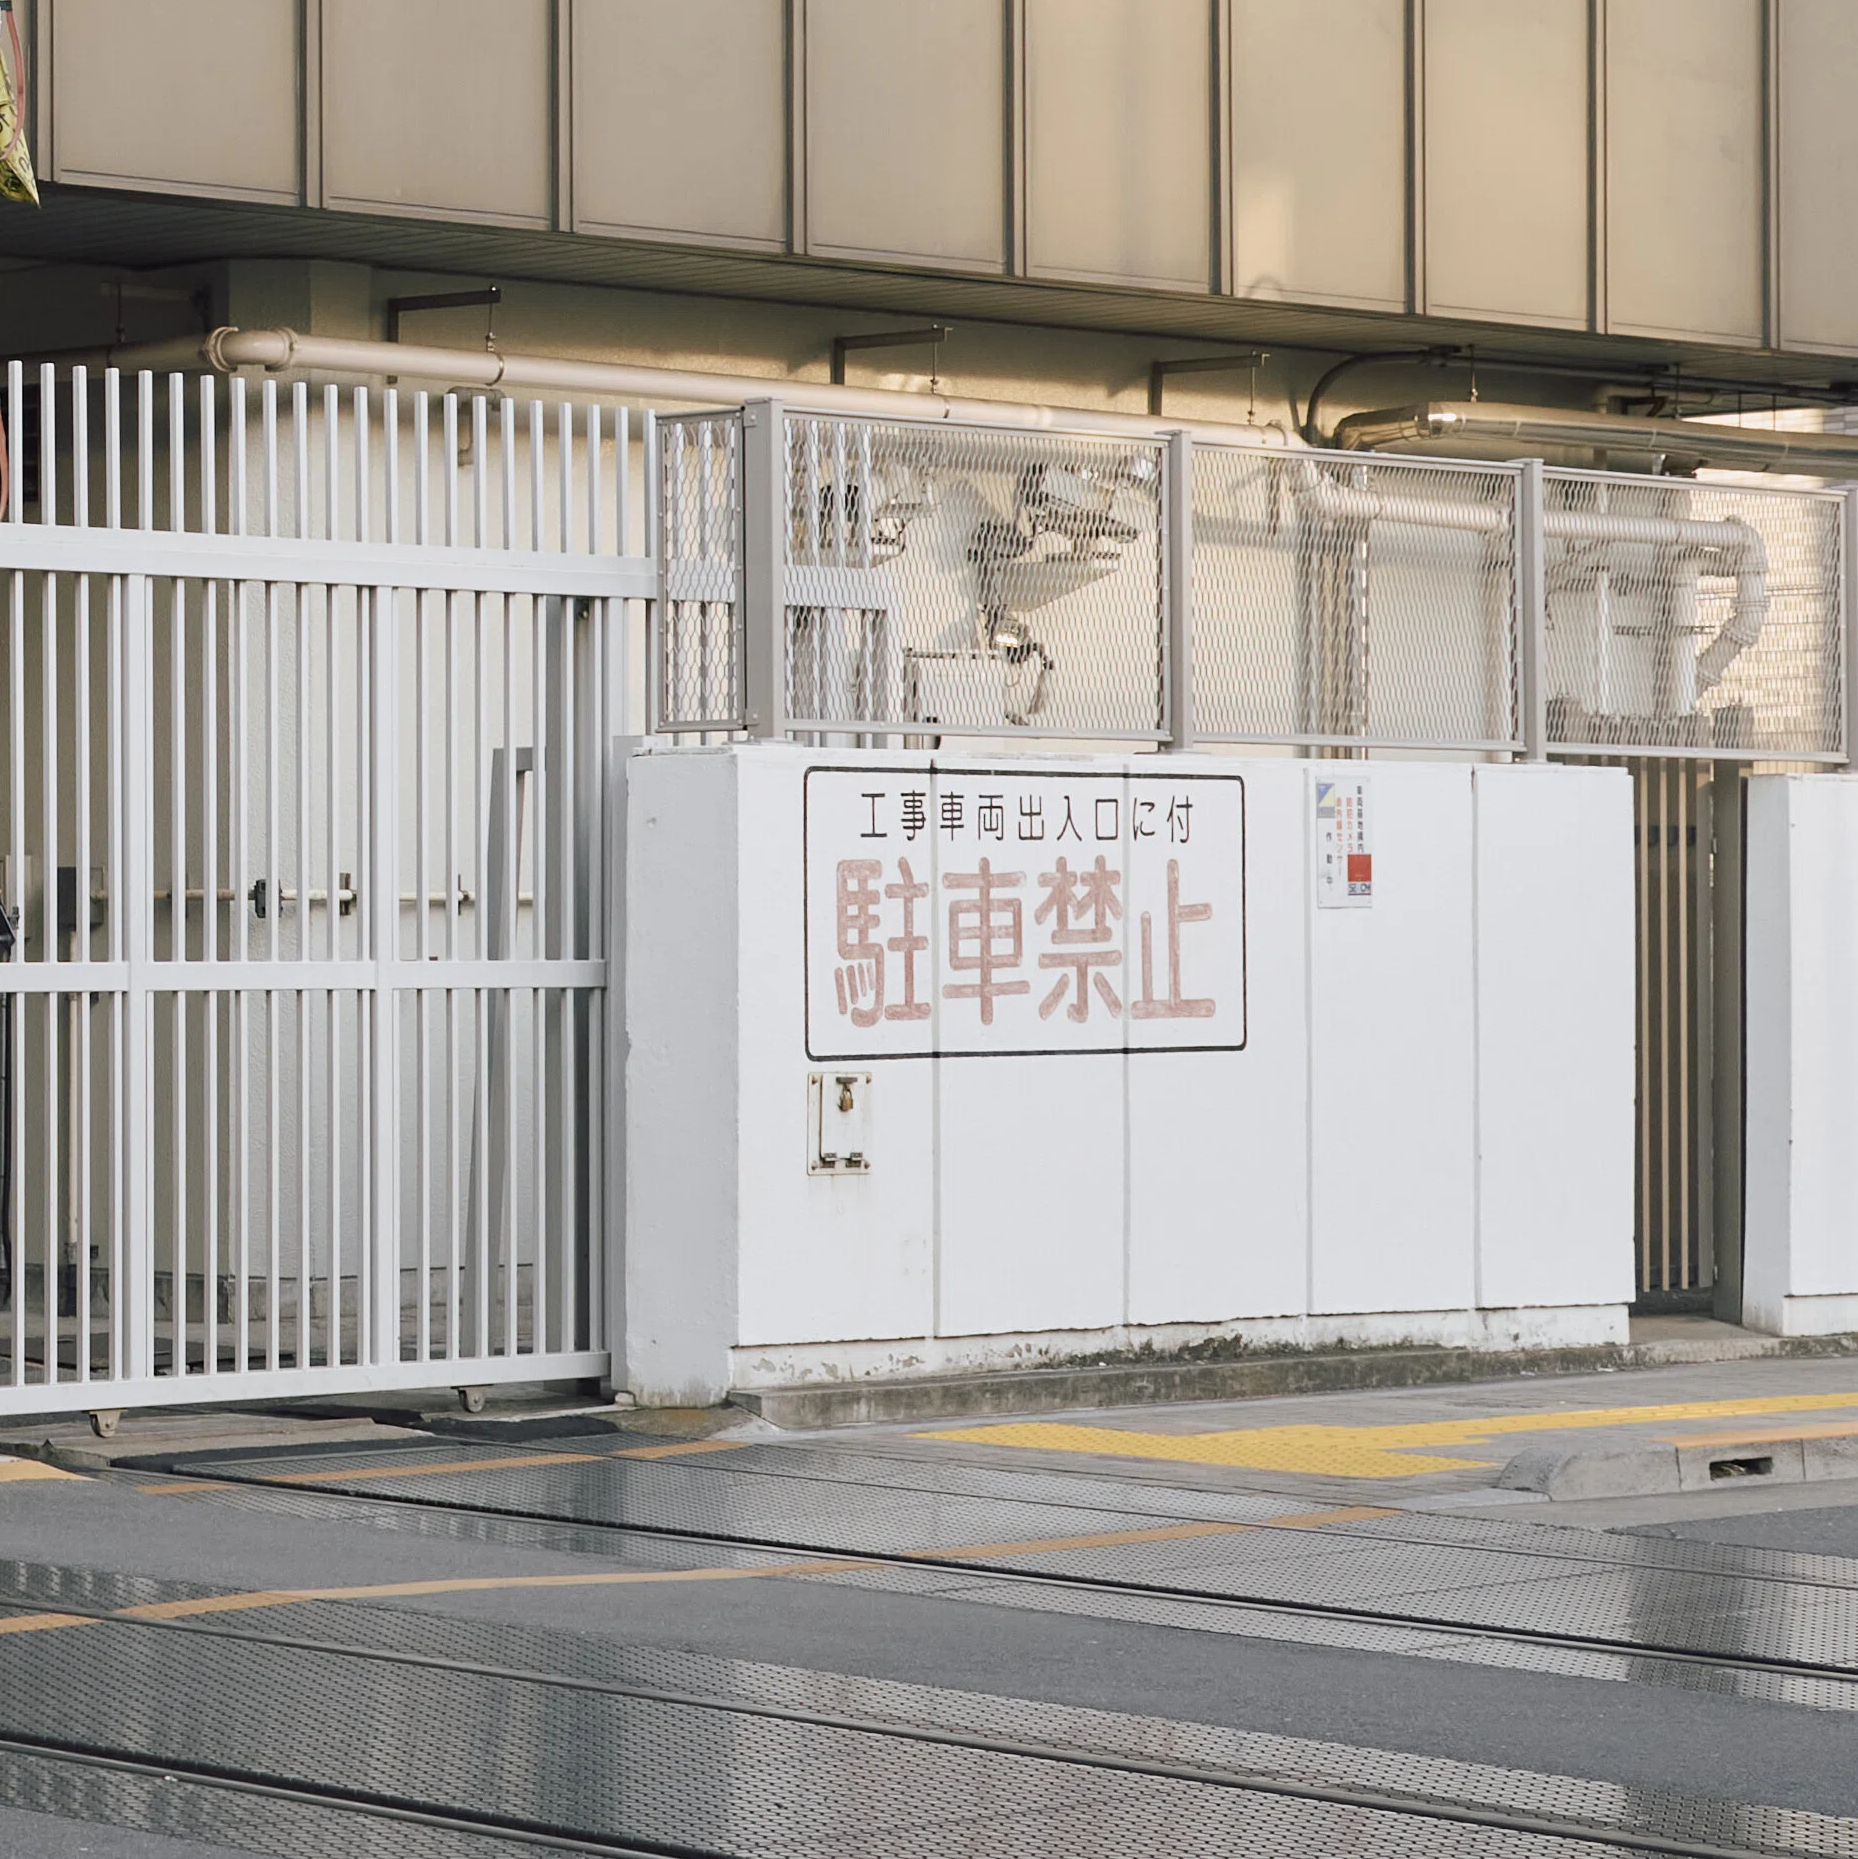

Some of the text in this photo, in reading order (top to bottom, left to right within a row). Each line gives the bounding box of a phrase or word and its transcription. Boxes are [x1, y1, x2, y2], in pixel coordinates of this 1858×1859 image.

[860, 790, 1194, 843] 工事車両出入口に付
[834, 854, 1216, 1028] 駐車禁止
